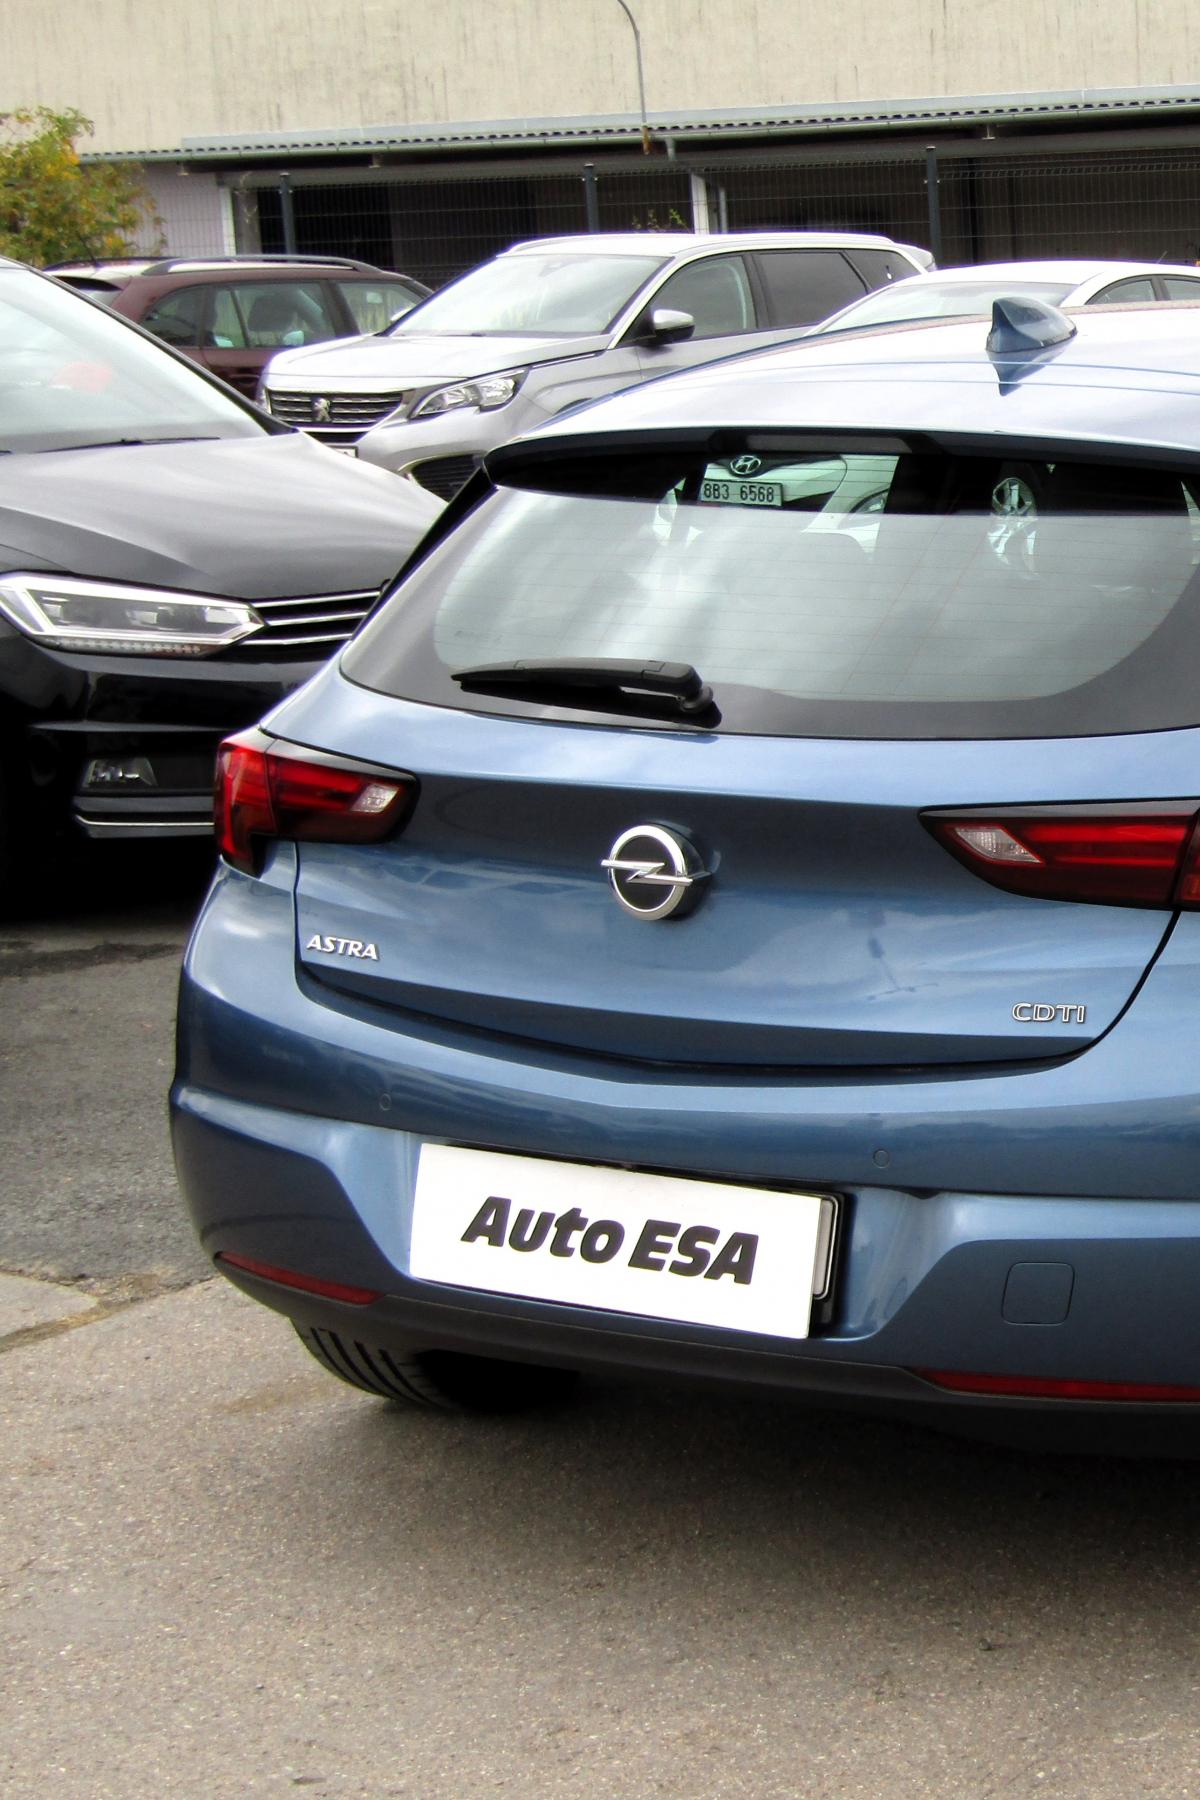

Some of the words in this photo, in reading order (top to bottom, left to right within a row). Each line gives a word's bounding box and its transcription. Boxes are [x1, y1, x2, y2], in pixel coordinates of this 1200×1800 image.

[703, 483, 729, 500] 8B3
[740, 485, 774, 503] 6568
[306, 934, 379, 961] ASTRA
[1011, 1002, 1086, 1024] CDTI
[460, 1196, 625, 1264] Auto
[627, 1218, 759, 1285] ESA
